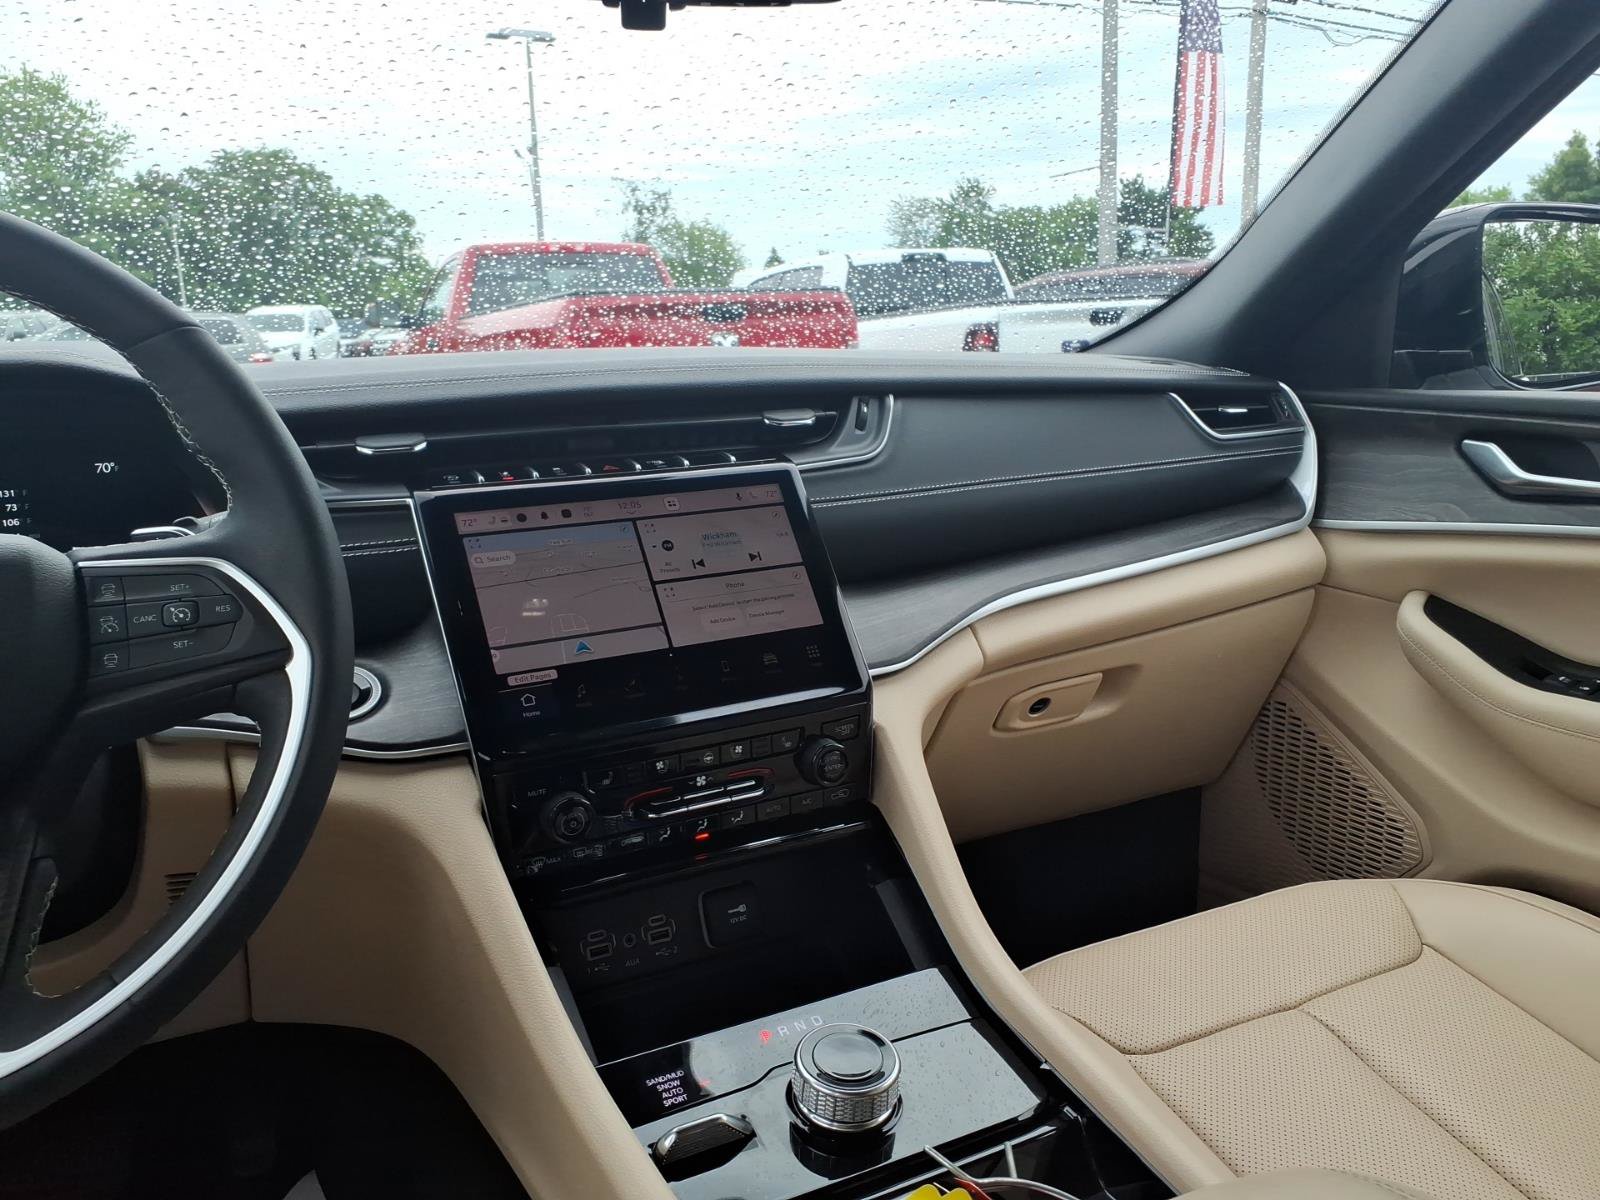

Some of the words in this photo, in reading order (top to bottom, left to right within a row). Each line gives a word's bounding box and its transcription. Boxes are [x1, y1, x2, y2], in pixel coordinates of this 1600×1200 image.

[486, 554, 511, 563] Search
[215, 604, 231, 613] RES
[133, 614, 158, 624] CANC
[514, 675, 528, 684] Edit
[529, 673, 552, 682] Pages
[522, 710, 541, 718] Home
[527, 788, 547, 798] MUTE
[777, 1026, 789, 1037] R
[793, 1020, 807, 1031] N
[811, 1015, 824, 1026] D
[645, 1069, 685, 1088] SAND/MUD
[656, 1079, 681, 1092] SNOW
[662, 1086, 684, 1099] AUTO
[663, 1093, 688, 1108] SPORT
